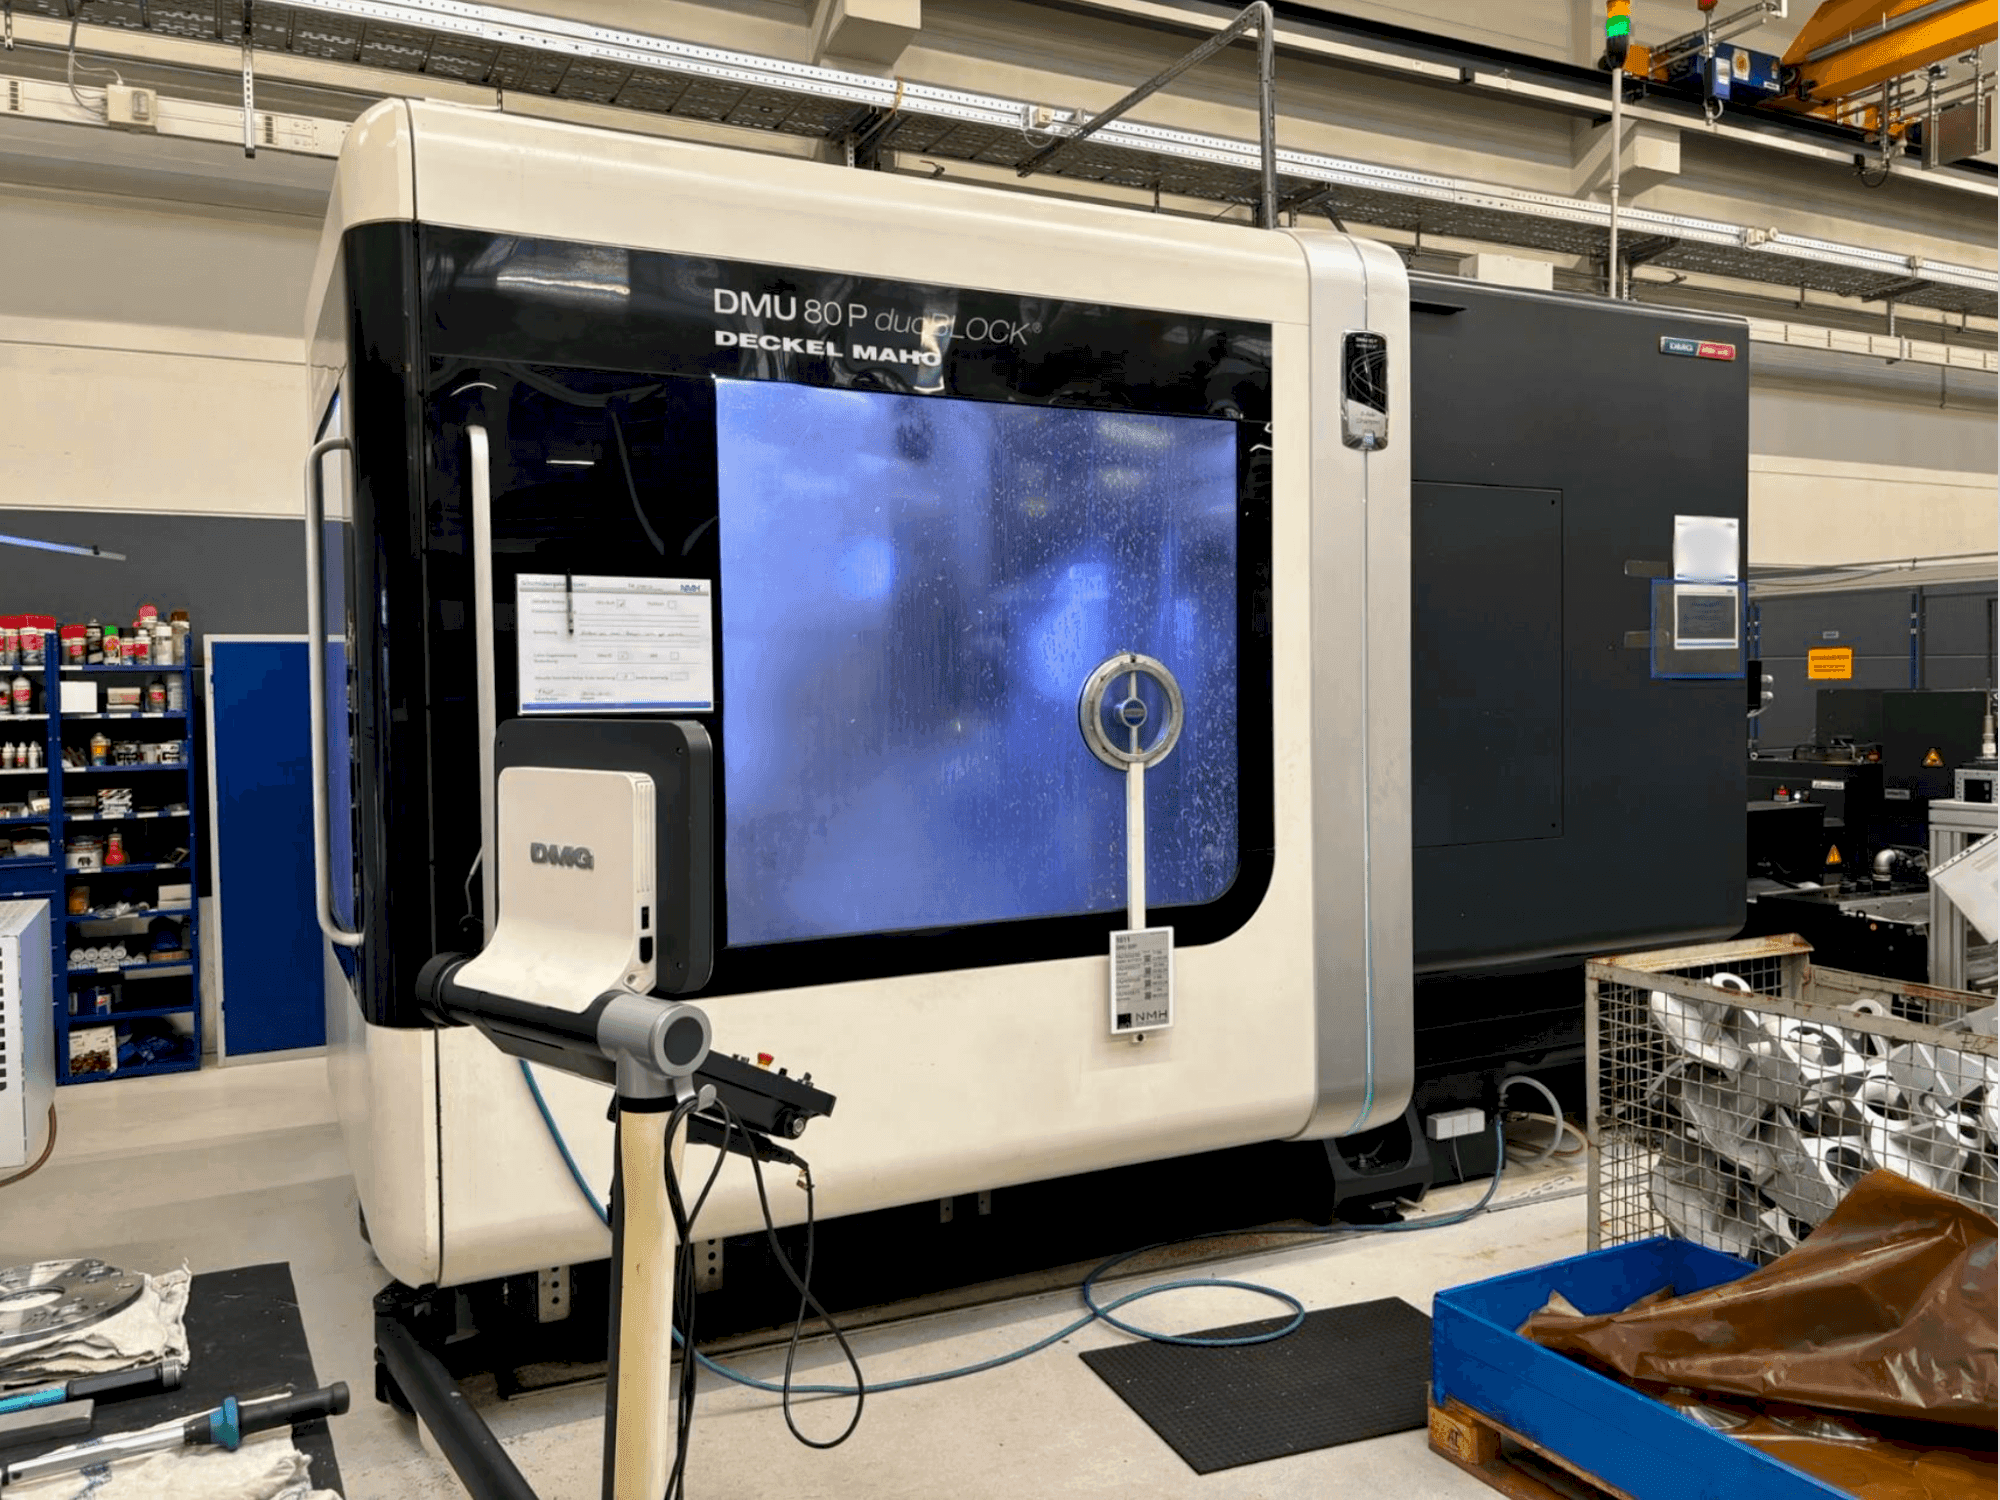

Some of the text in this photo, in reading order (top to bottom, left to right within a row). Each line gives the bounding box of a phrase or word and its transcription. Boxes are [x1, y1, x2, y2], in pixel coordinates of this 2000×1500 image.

[713, 288, 797, 321] DMU
[804, 299, 842, 326] 80
[848, 303, 868, 327] P
[715, 330, 942, 366] DECKEL MAHO
[530, 842, 595, 871] DMG
[1135, 1009, 1168, 1021] NMH
